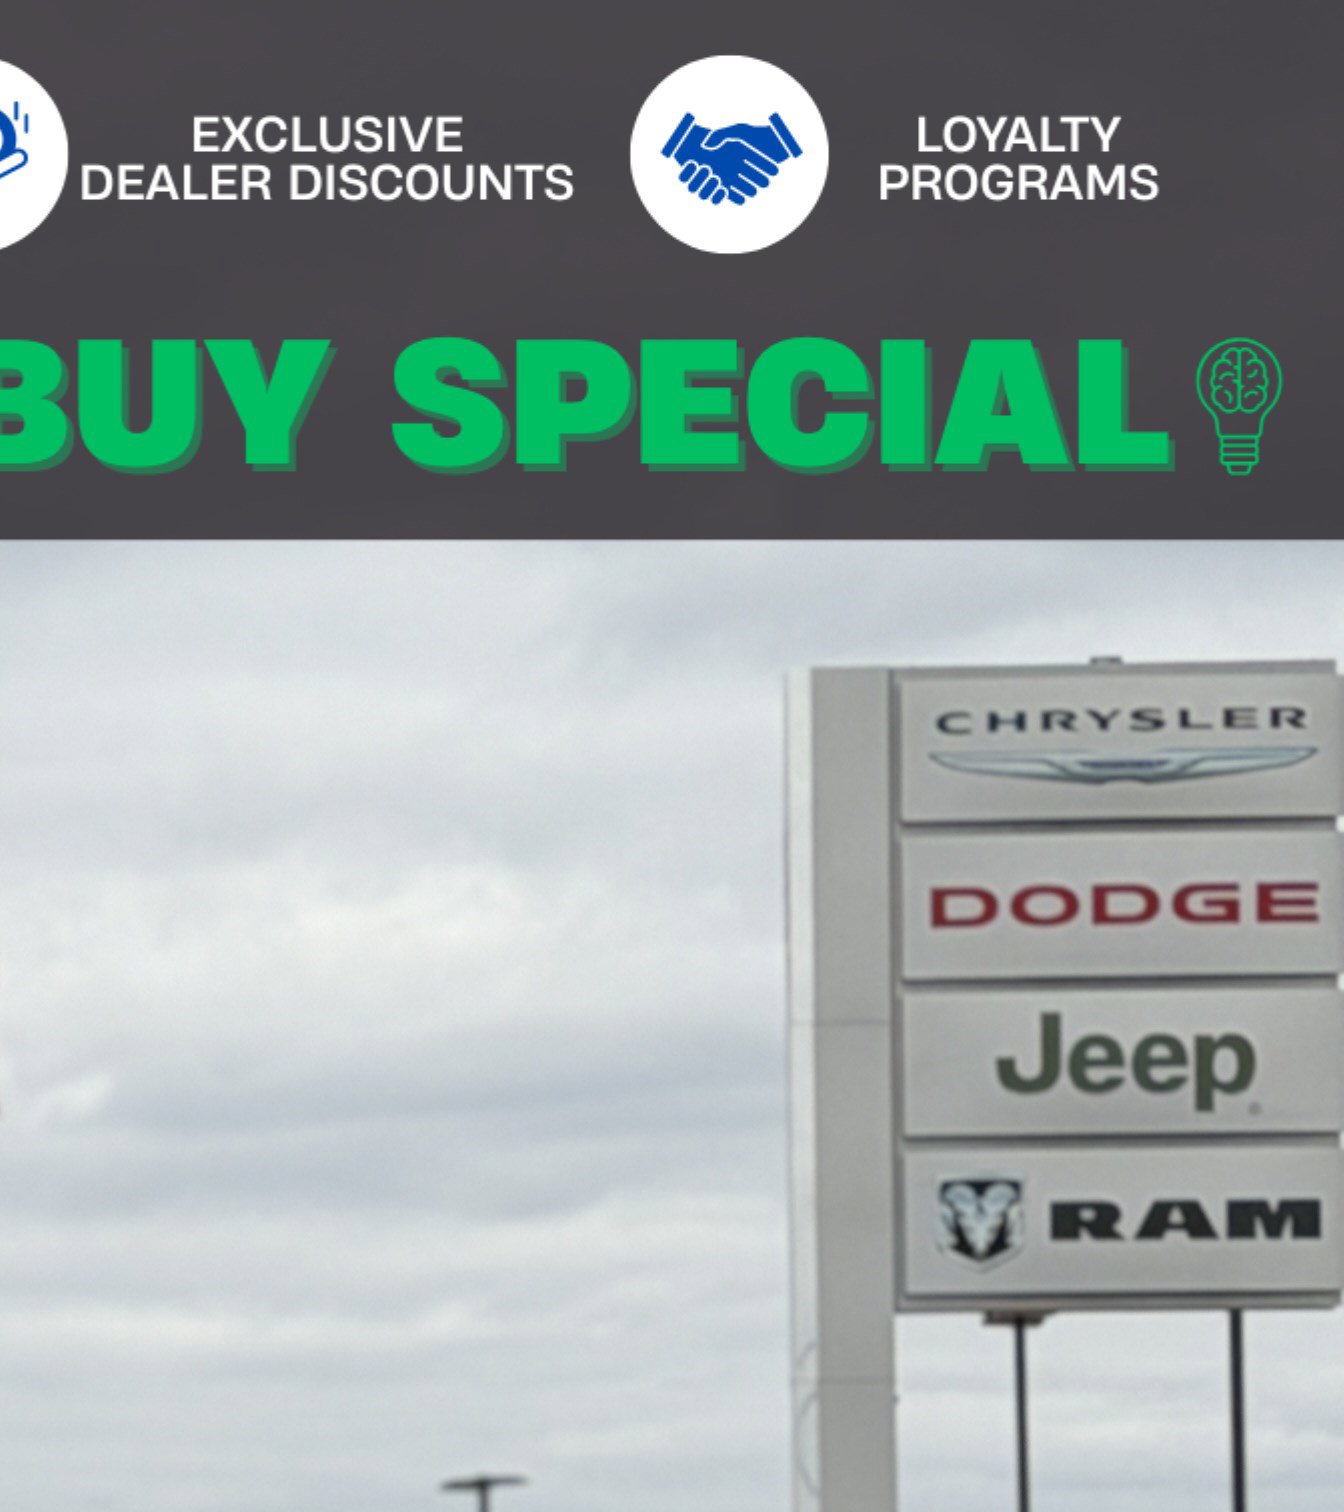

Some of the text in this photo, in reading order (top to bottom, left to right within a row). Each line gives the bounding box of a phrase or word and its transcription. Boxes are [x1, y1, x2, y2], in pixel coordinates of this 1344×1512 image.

[934, 705, 1309, 737] CHRYSLER
[929, 881, 1321, 930] DODGE
[996, 1011, 1258, 1113] Jeep
[1049, 1197, 1323, 1243] RAM
